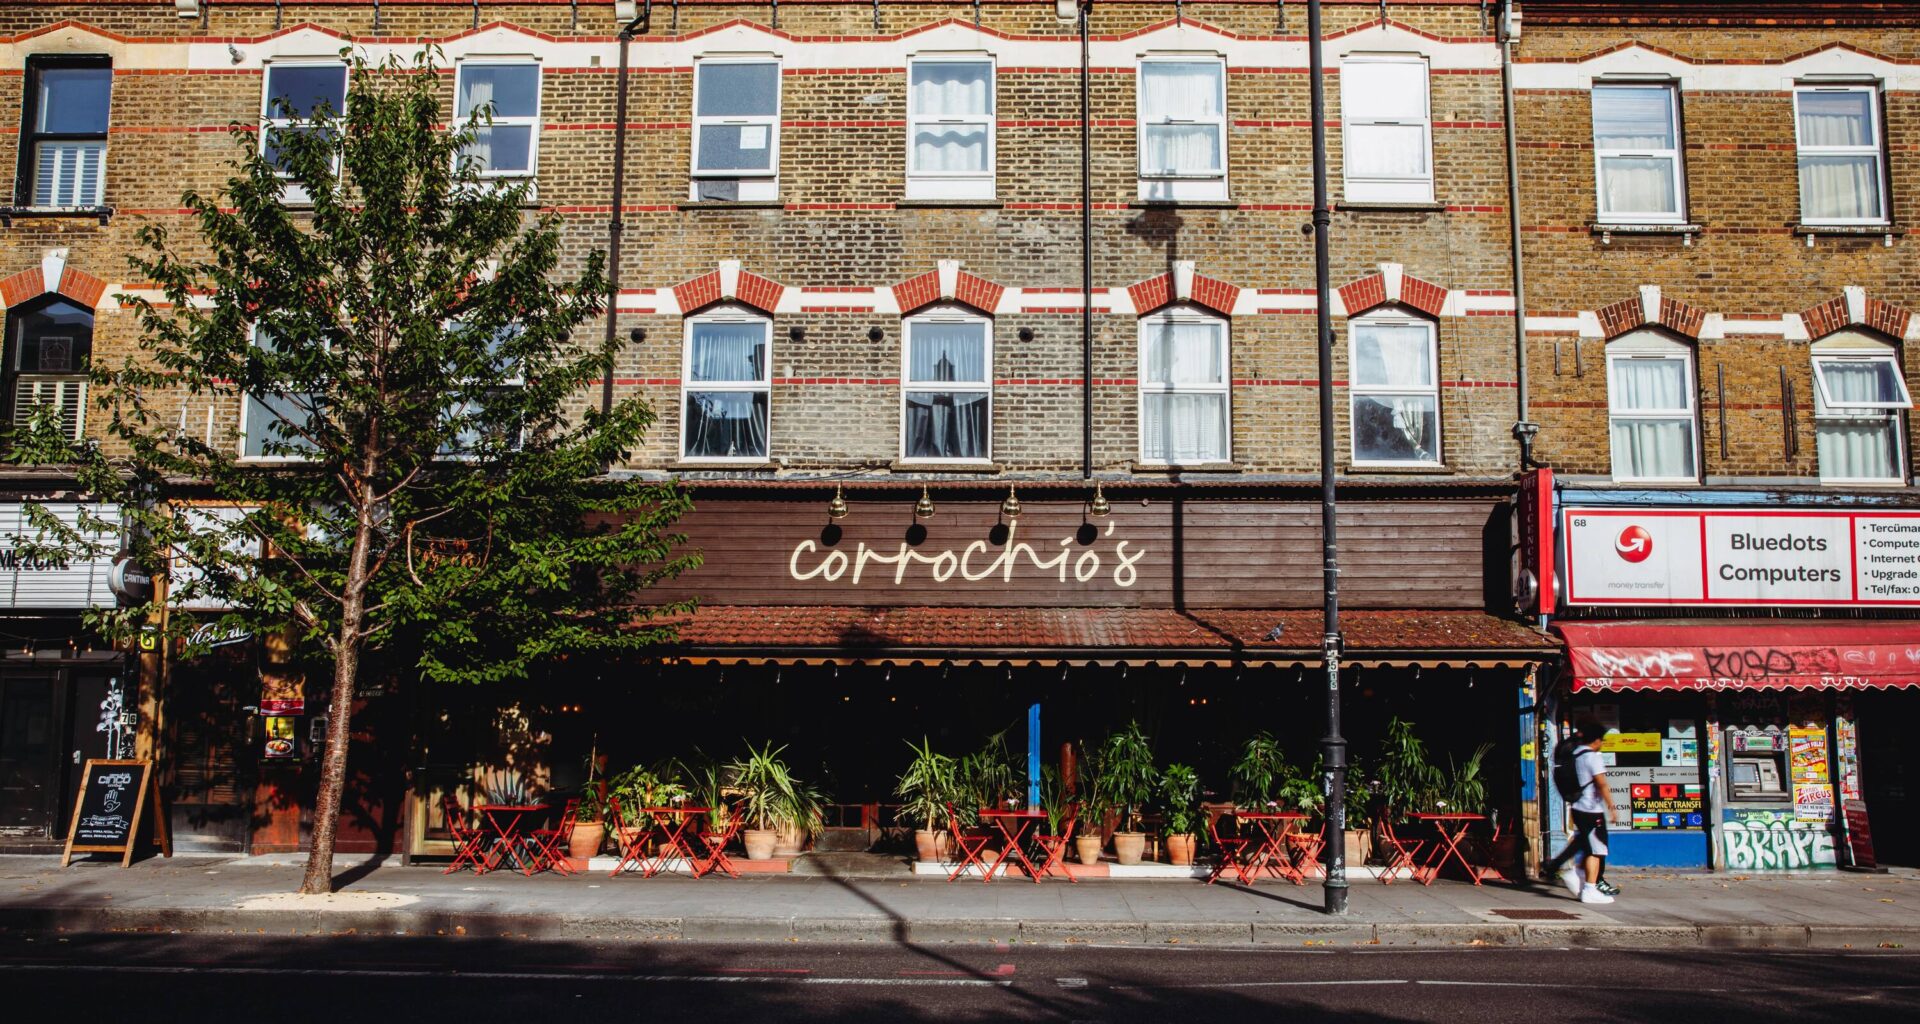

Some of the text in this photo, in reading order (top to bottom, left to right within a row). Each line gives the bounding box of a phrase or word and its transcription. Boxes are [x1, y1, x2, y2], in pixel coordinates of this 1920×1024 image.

[1573, 519, 1587, 527] 68
[1731, 533, 1828, 551] Bluedots
[789, 519, 1145, 588] corrochio's
[1870, 554, 1916, 563] Internet
[1719, 564, 1841, 586] Computers
[1871, 570, 1918, 580] Upgrade
[1634, 581, 1665, 589] transfer
[1870, 585, 1911, 595] Tel/fax:
[1633, 801, 1647, 809] YPS
[1647, 801, 1673, 809] MONEY
